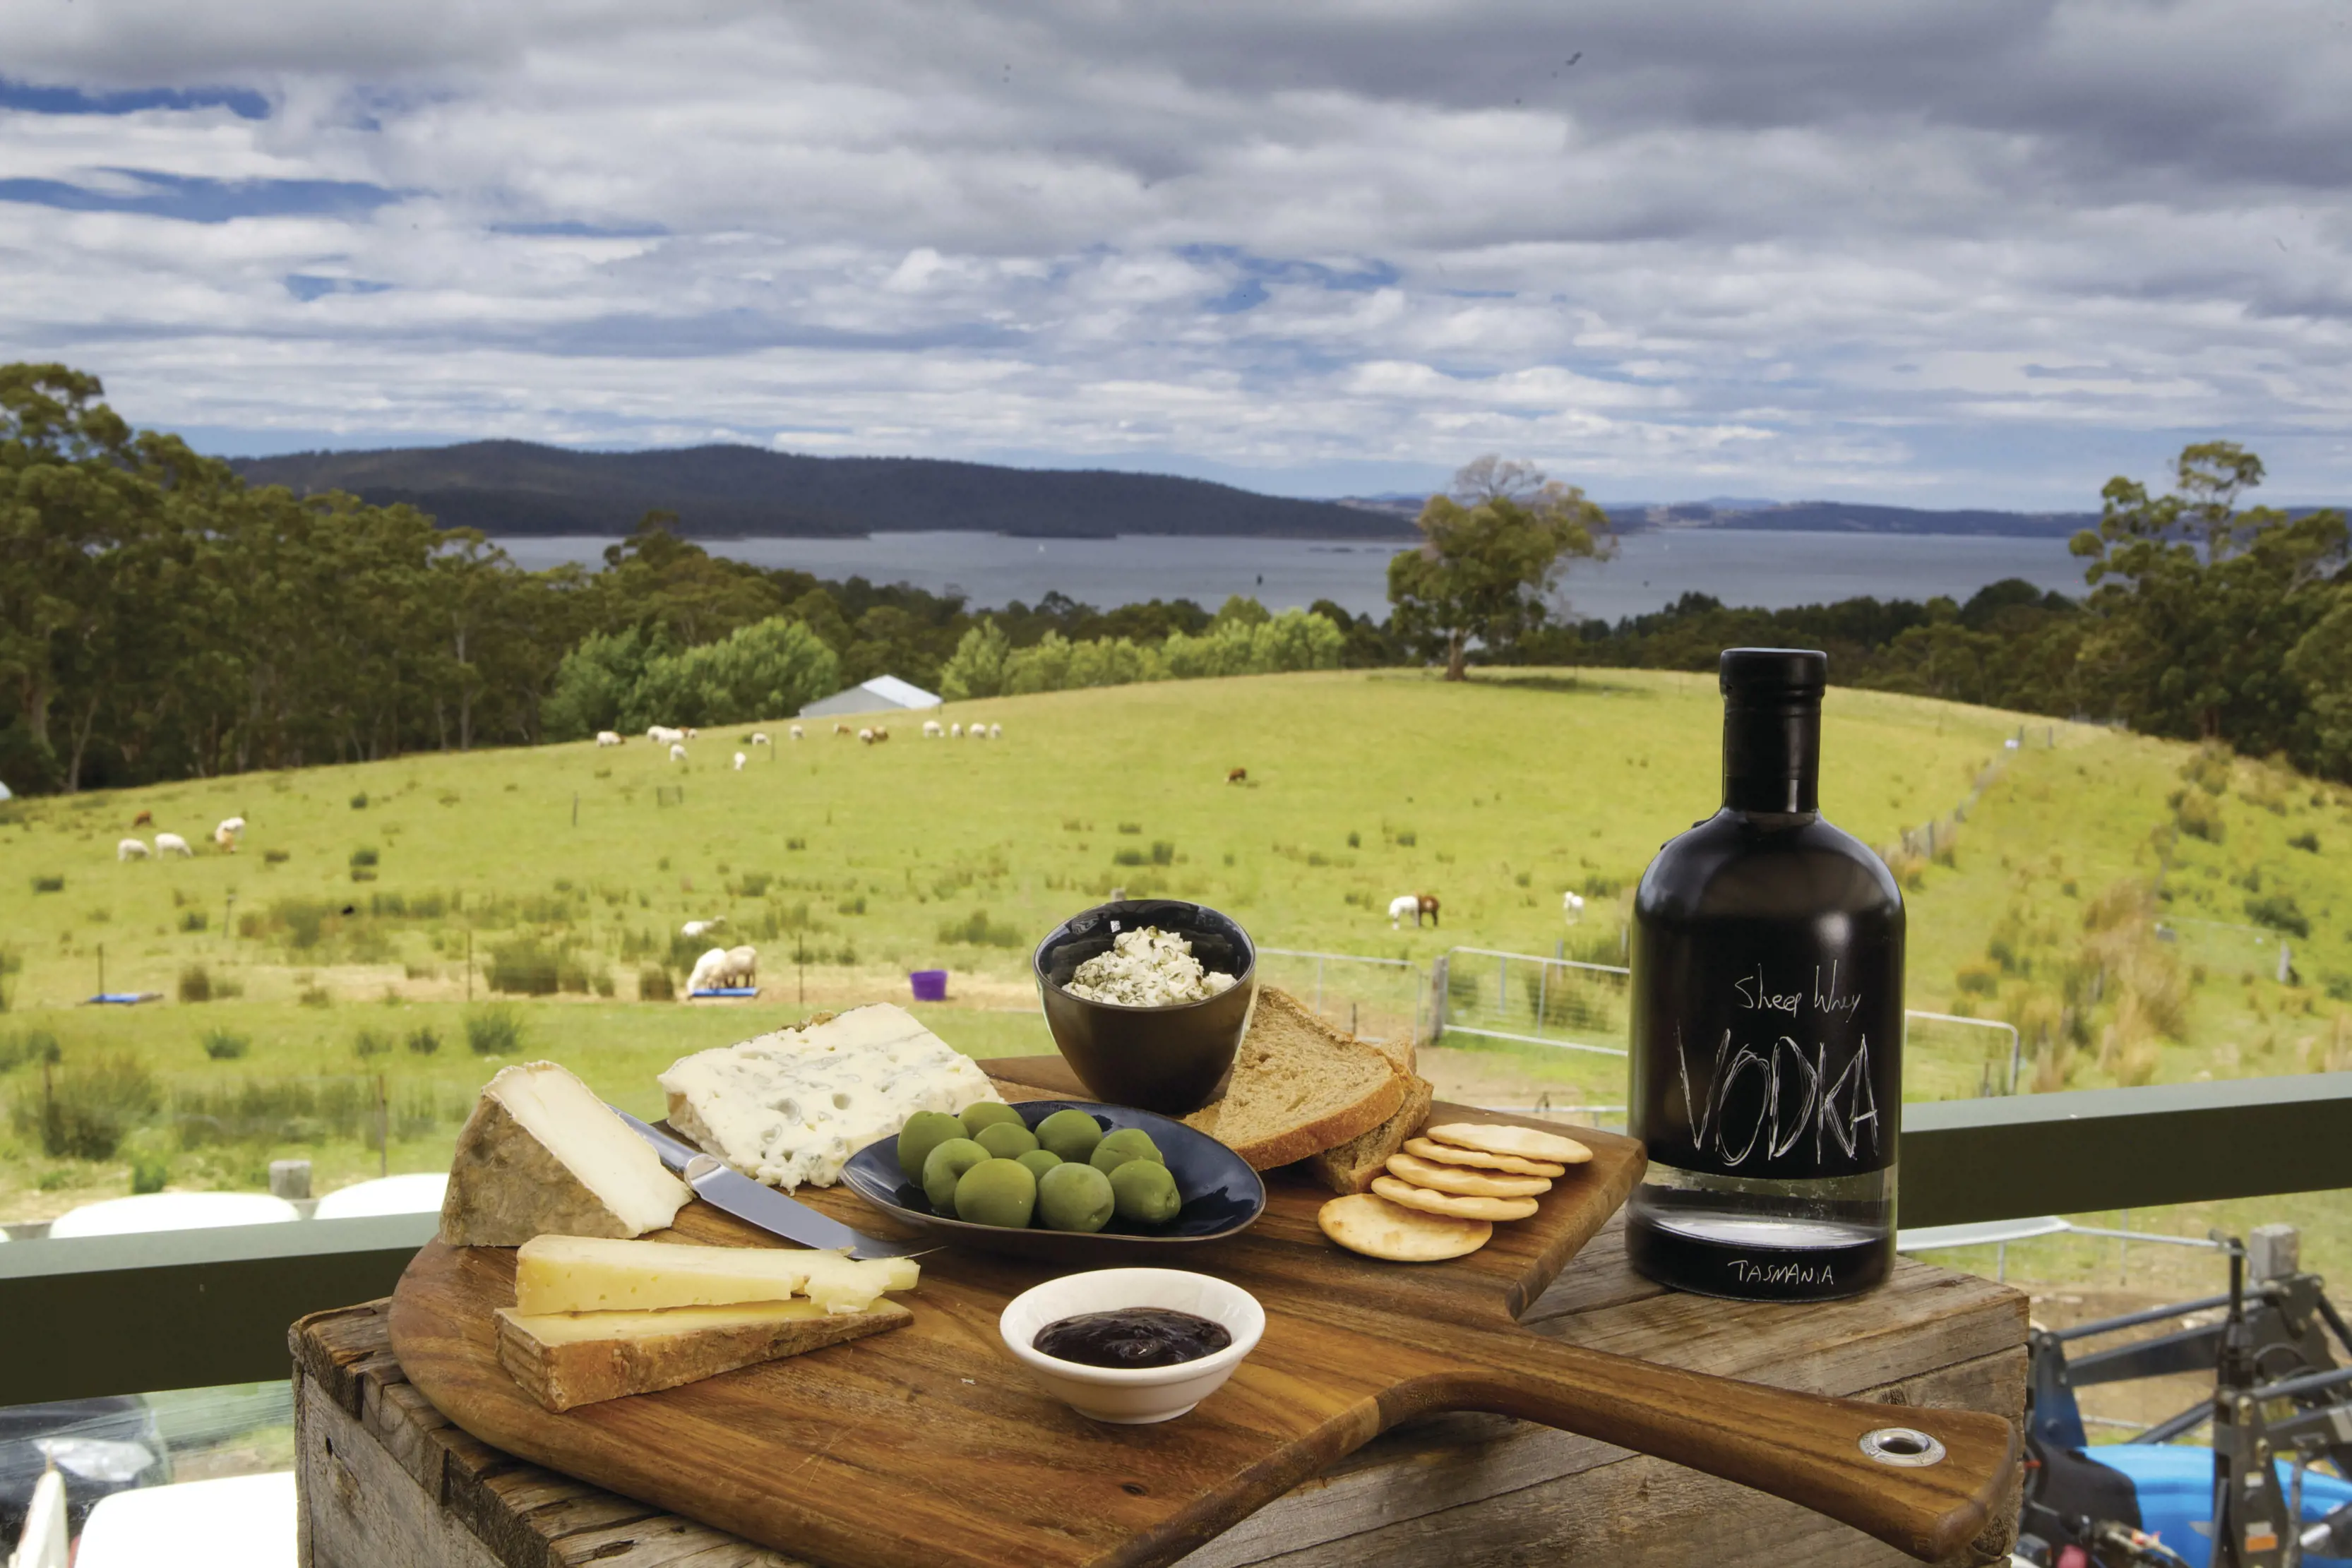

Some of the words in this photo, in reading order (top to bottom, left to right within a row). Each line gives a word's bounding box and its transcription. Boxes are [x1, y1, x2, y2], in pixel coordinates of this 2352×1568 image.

[1735, 963, 1802, 1018] Sheep
[1814, 959, 1861, 1023] Whey
[1674, 1021, 1878, 1167] VODKA
[1728, 1259, 1834, 1285] TASMANIA
